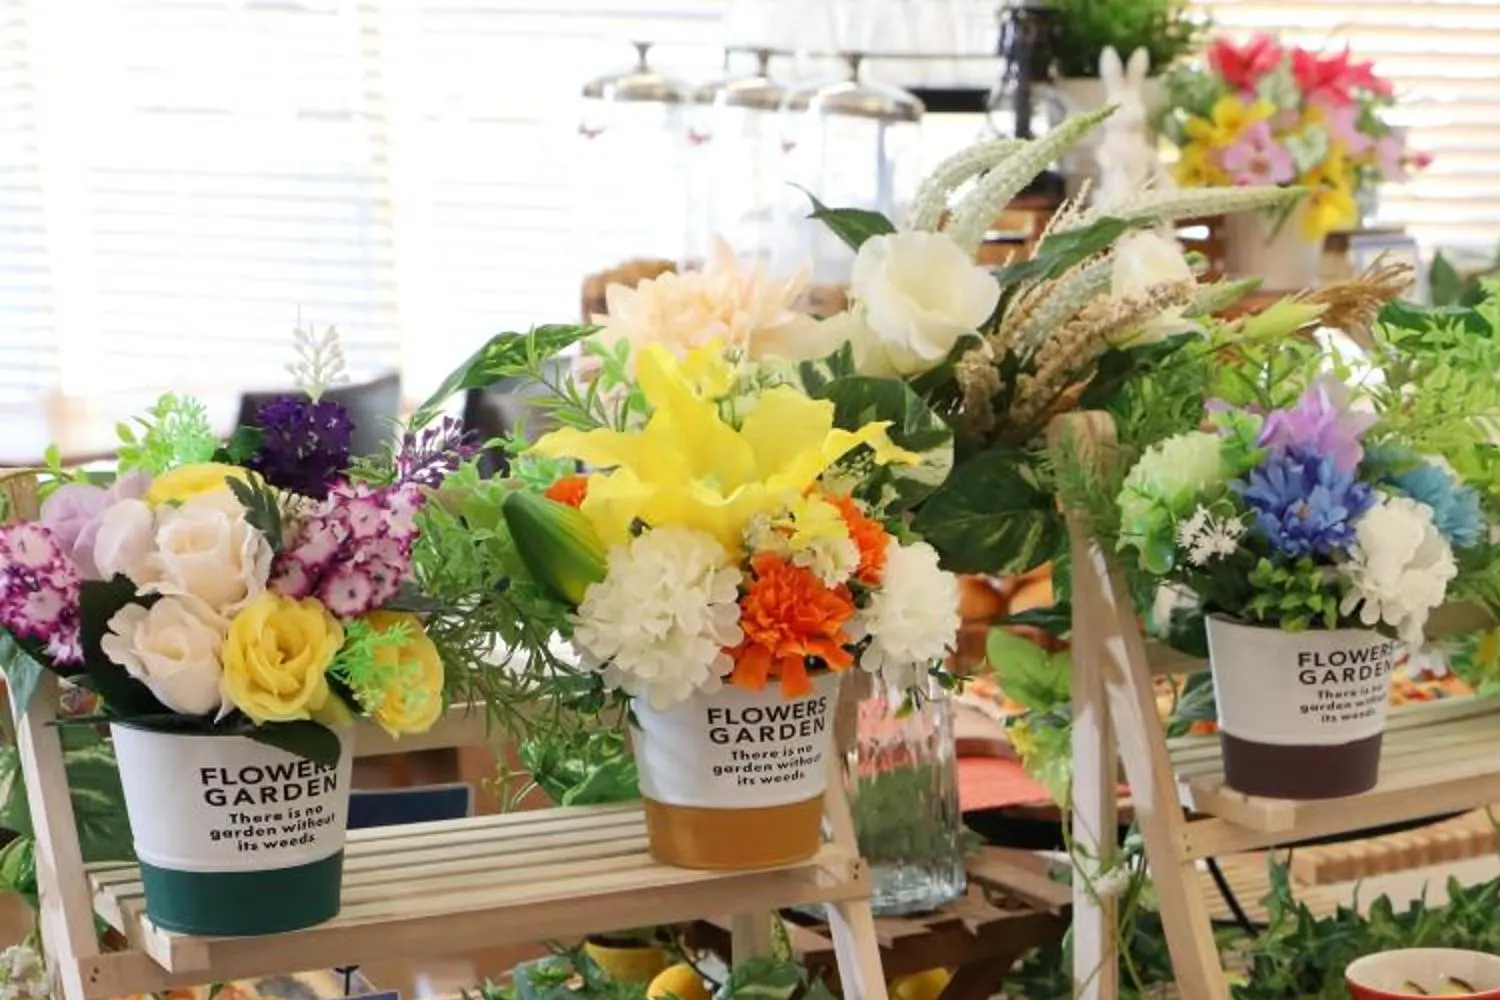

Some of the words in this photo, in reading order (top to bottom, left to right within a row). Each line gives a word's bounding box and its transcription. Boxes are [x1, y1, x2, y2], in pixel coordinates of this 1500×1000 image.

[1299, 659, 1391, 685] GARDEN
[707, 696, 827, 725] FLOWERS
[709, 716, 825, 744] GARDEN
[732, 749, 779, 760] There
[783, 745, 794, 757] is
[797, 745, 812, 754] no
[713, 762, 773, 776] garden
[737, 775, 755, 785] its
[760, 770, 805, 784] weeds
[204, 773, 337, 807] GARDEN
[230, 811, 283, 824] There
[288, 807, 301, 819] is
[305, 804, 323, 816] no
[210, 825, 277, 841] garden
[237, 839, 259, 851] its
[263, 831, 316, 849] weeds
